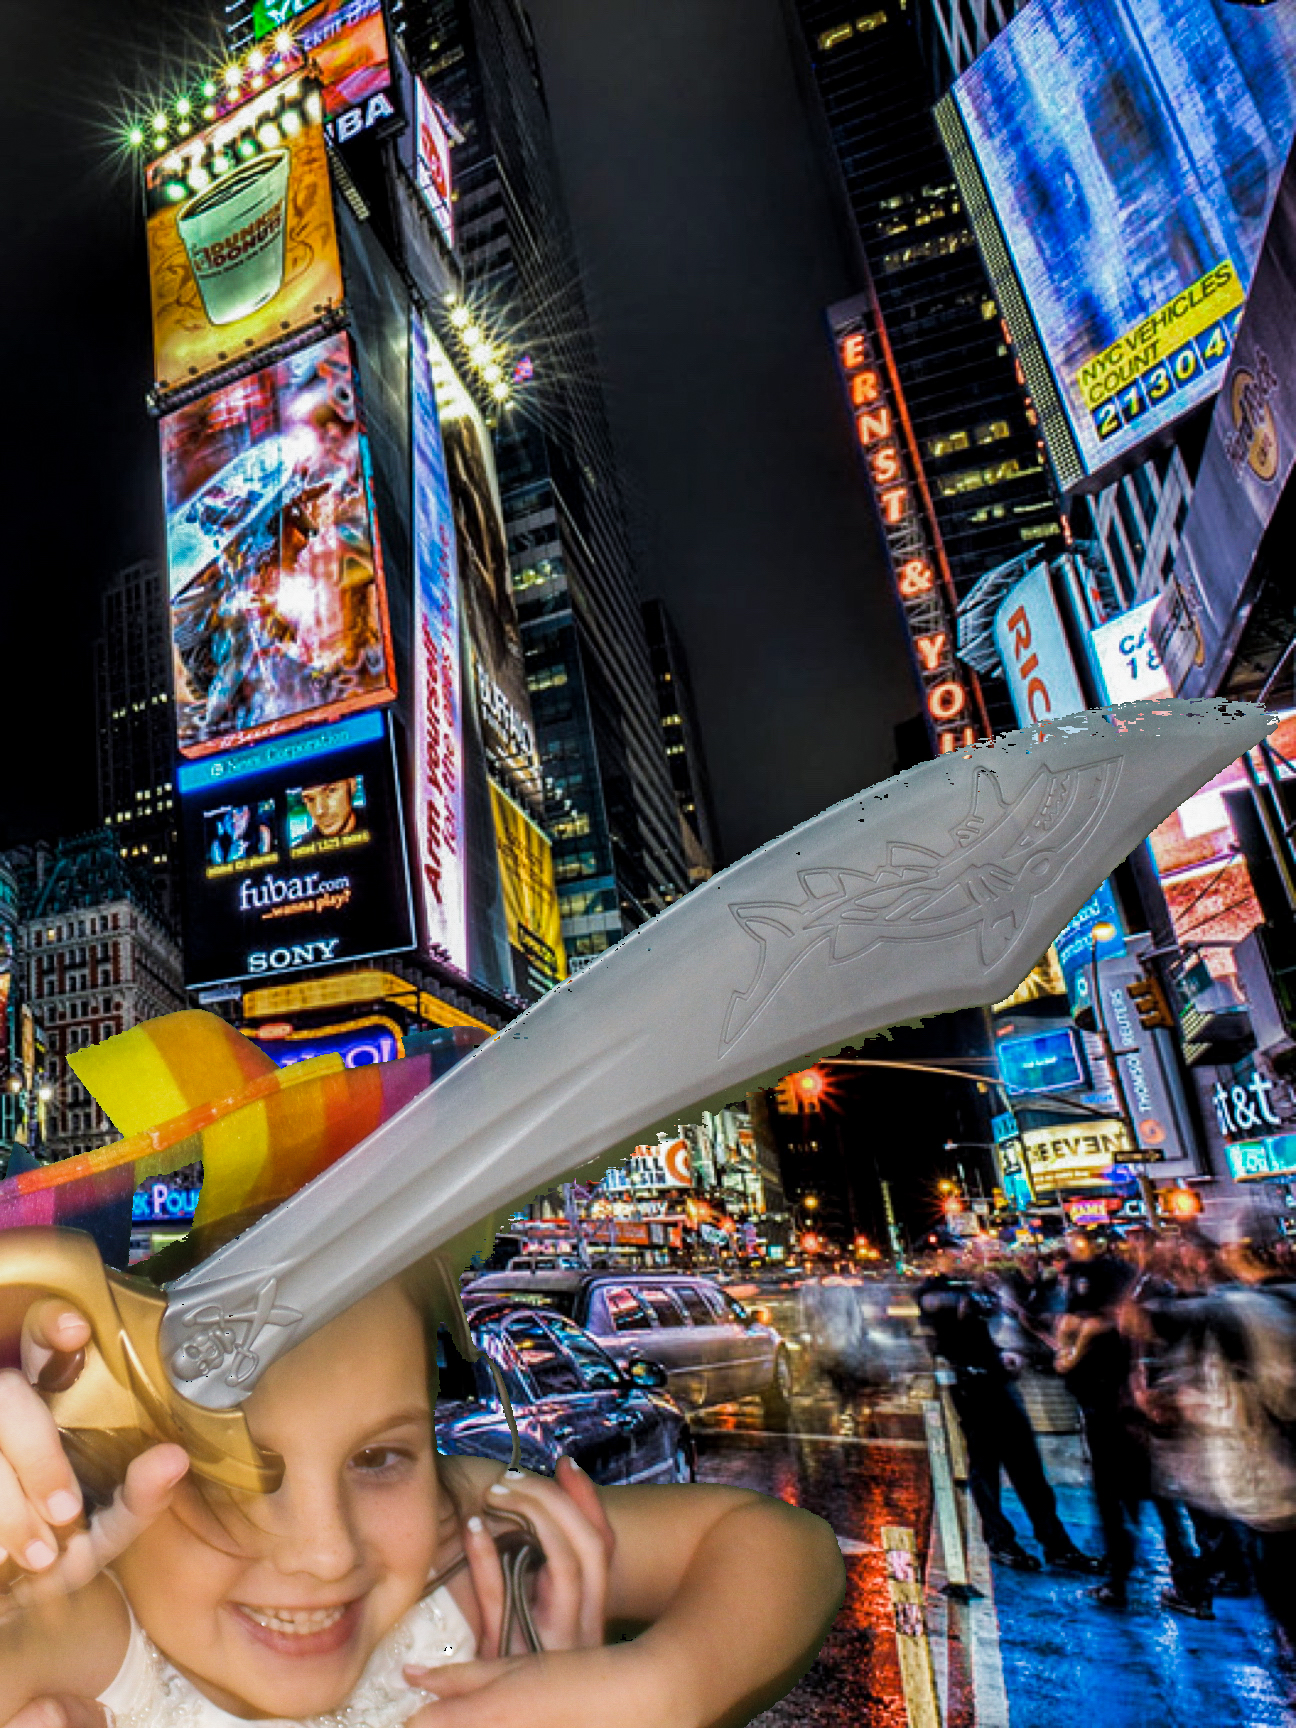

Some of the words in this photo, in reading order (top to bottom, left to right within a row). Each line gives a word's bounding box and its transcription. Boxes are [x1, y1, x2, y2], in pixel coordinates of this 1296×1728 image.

[1083, 343, 1124, 386] NYC
[1125, 264, 1232, 351] VEHICLES
[1089, 338, 1160, 403] COUNT
[841, 333, 907, 523] ERNST
[238, 871, 351, 911] fubar.com
[247, 936, 341, 974] SONY
